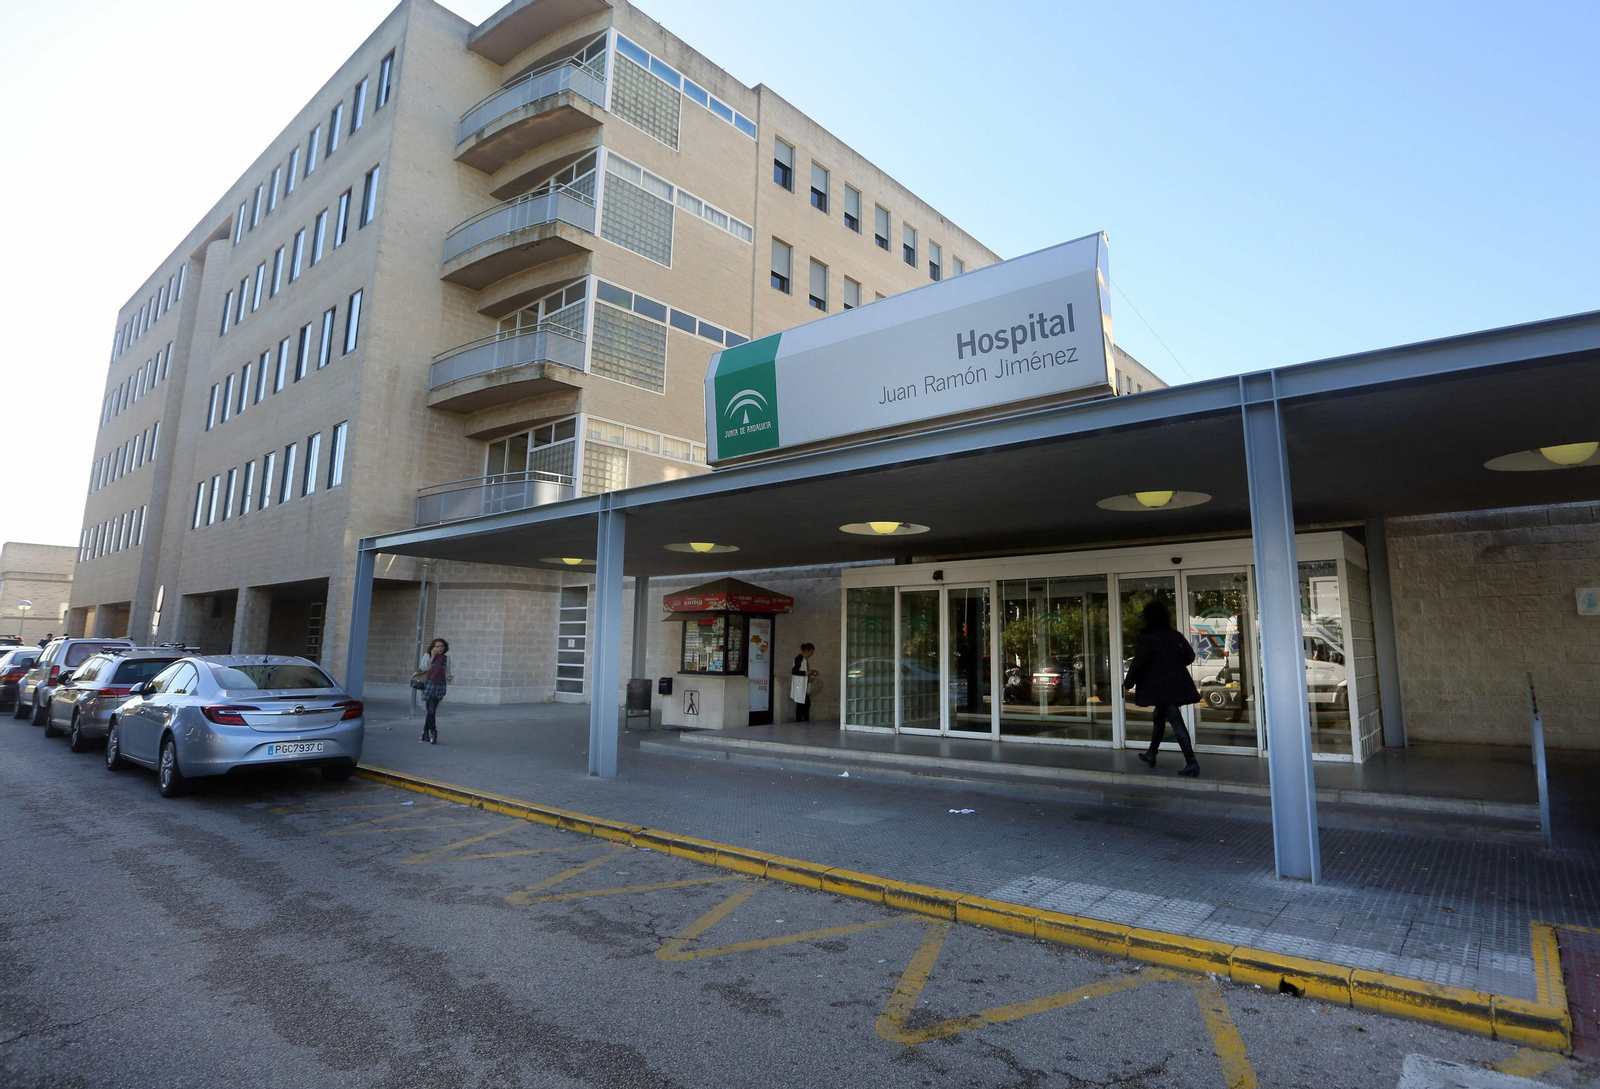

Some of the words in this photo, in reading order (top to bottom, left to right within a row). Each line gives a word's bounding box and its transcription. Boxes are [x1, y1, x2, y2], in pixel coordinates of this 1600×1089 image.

[956, 302, 1076, 360] Hospital
[878, 383, 917, 405] Juan
[924, 365, 988, 395] Ramón
[994, 346, 1079, 380] Jiménez
[724, 428, 739, 439] JUNTA
[740, 426, 746, 435] DE
